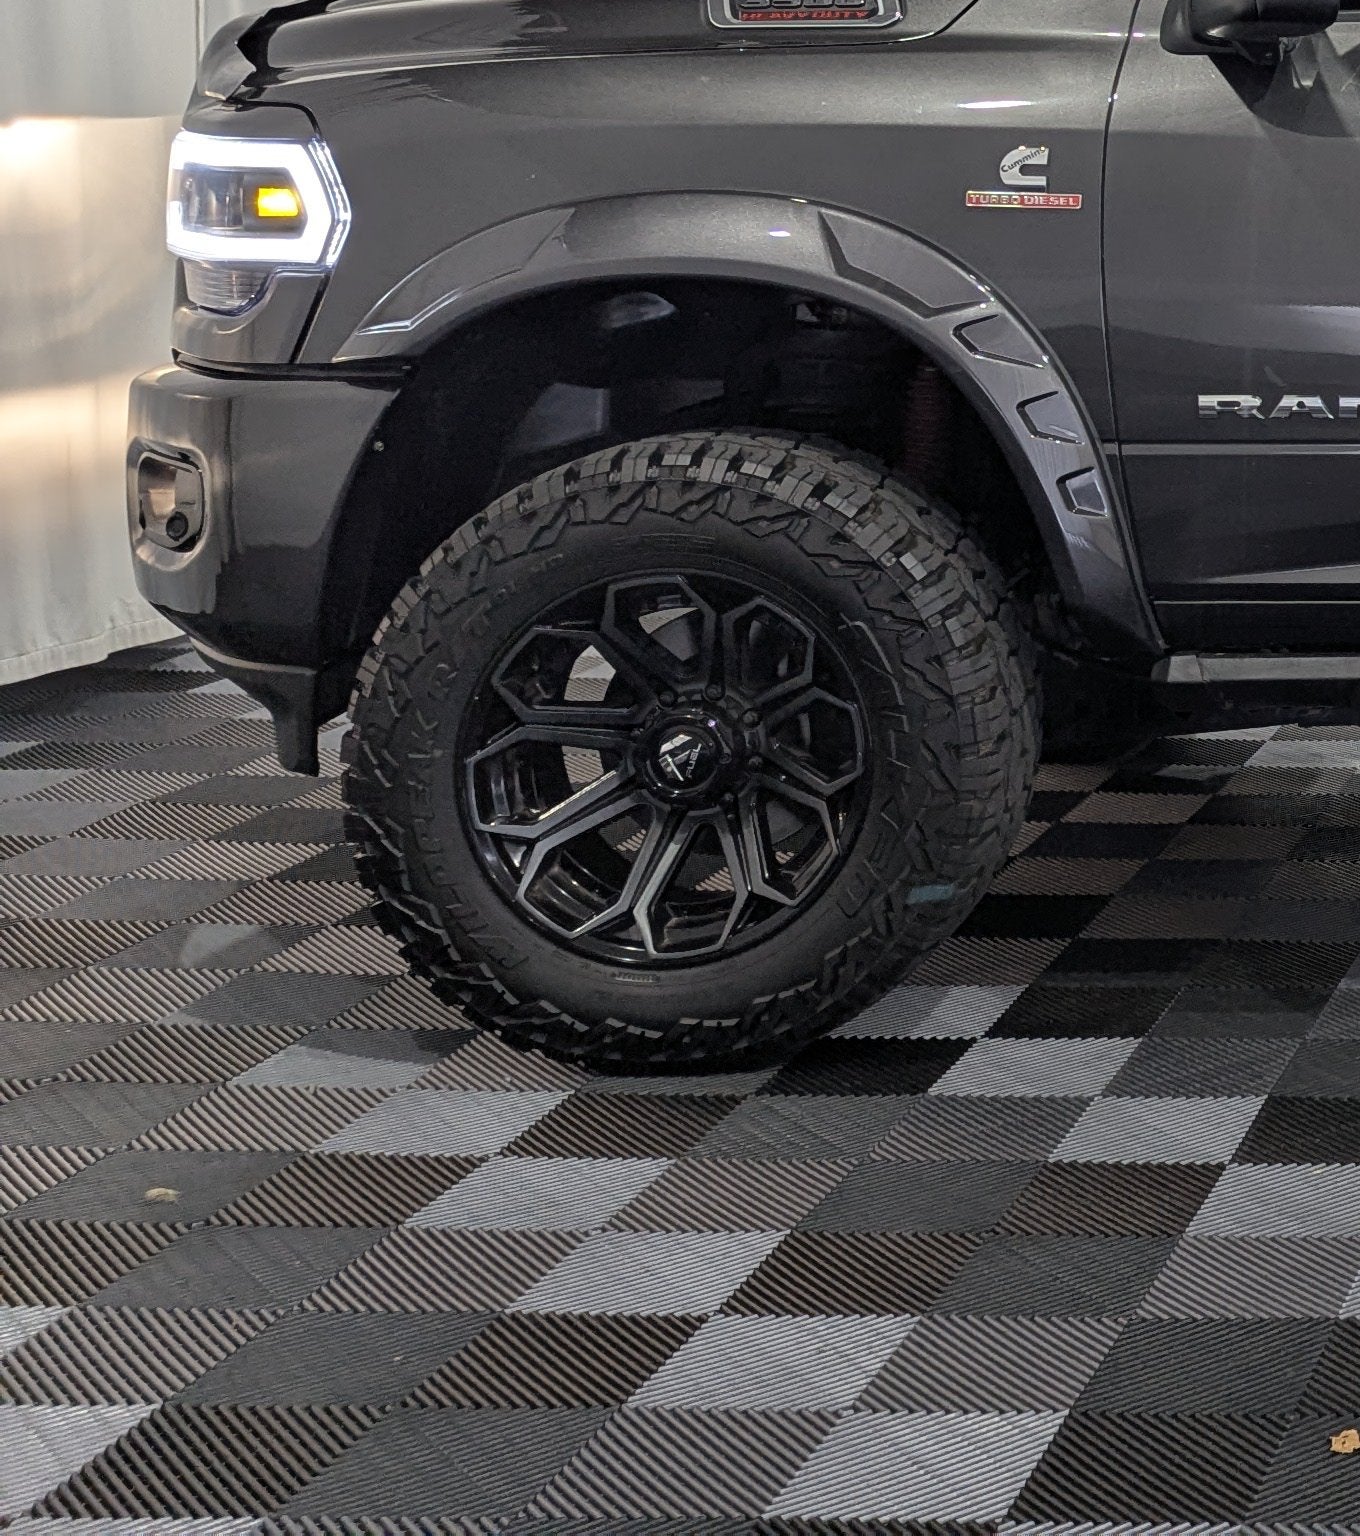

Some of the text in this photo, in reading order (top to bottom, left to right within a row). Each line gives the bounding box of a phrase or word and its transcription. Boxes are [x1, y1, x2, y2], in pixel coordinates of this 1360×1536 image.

[969, 194, 1079, 206] TURBO DIESEL
[685, 743, 703, 779] FUEL
